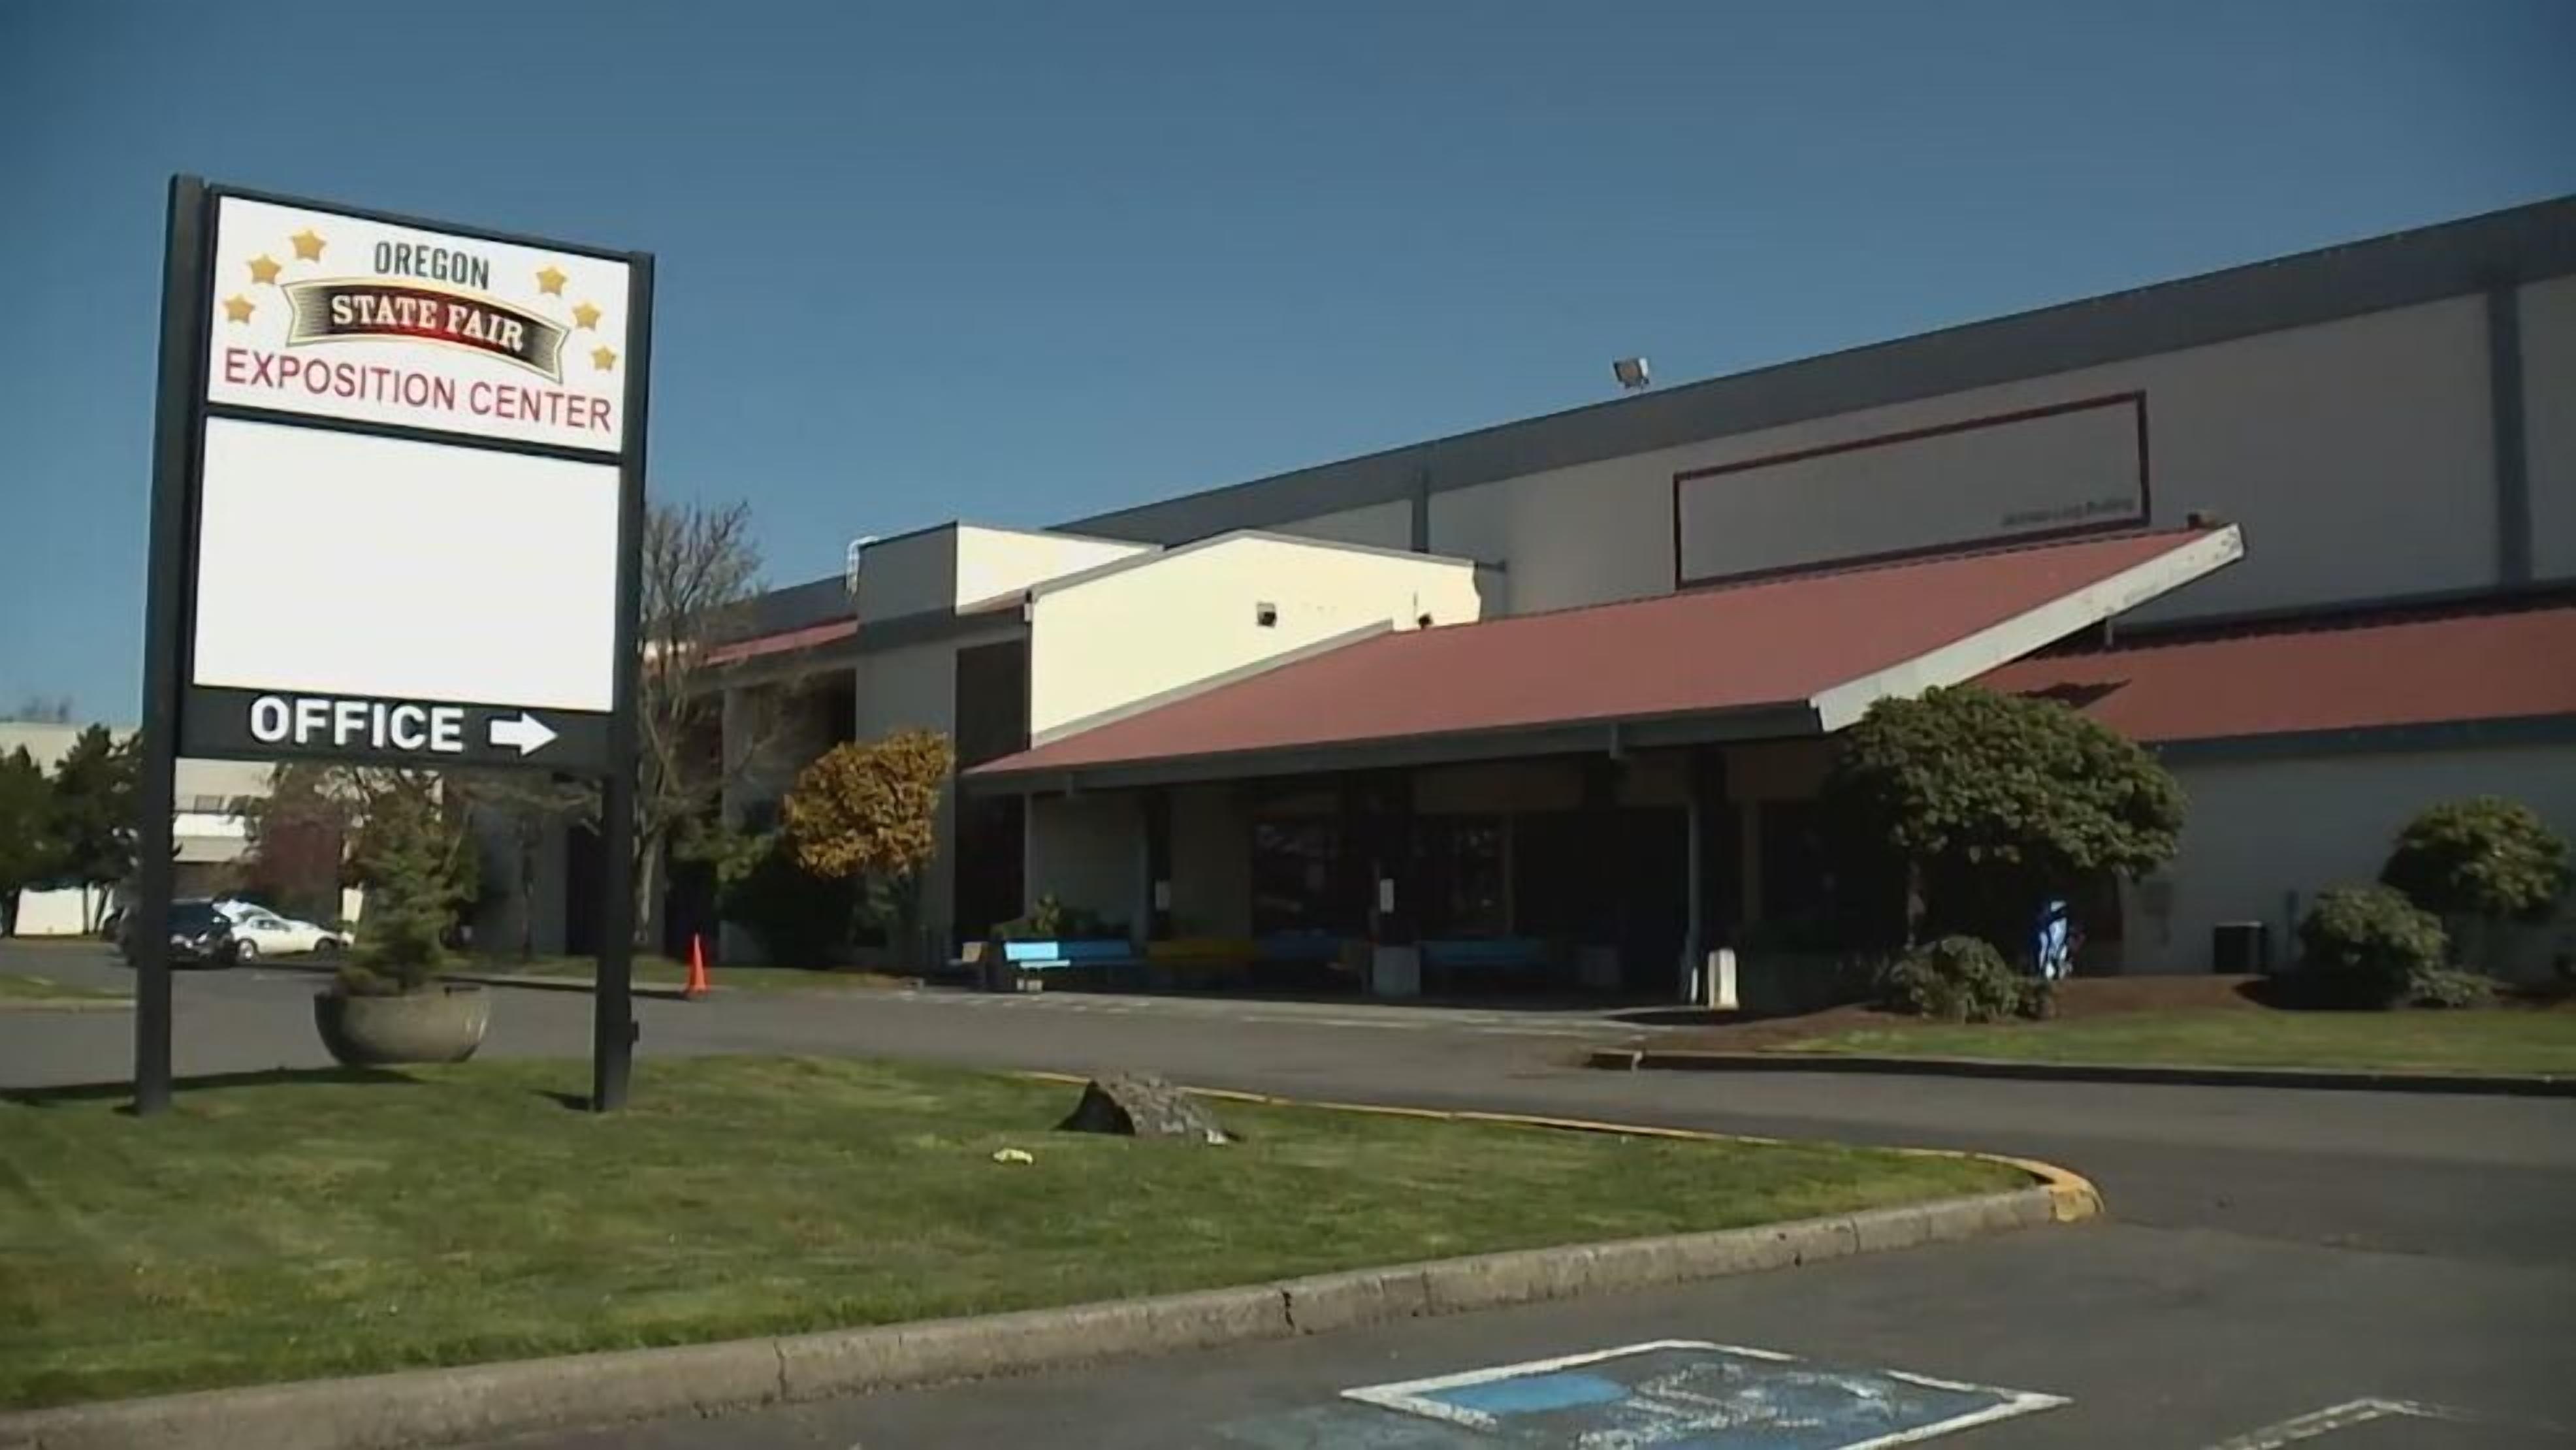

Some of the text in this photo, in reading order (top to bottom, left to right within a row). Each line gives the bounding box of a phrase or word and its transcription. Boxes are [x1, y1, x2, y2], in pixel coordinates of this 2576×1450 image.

[374, 241, 490, 290] OREGON
[331, 295, 524, 353] STATE FAIR
[224, 347, 611, 432] EXPOSITION CENTER
[250, 696, 464, 752] OFFICE
